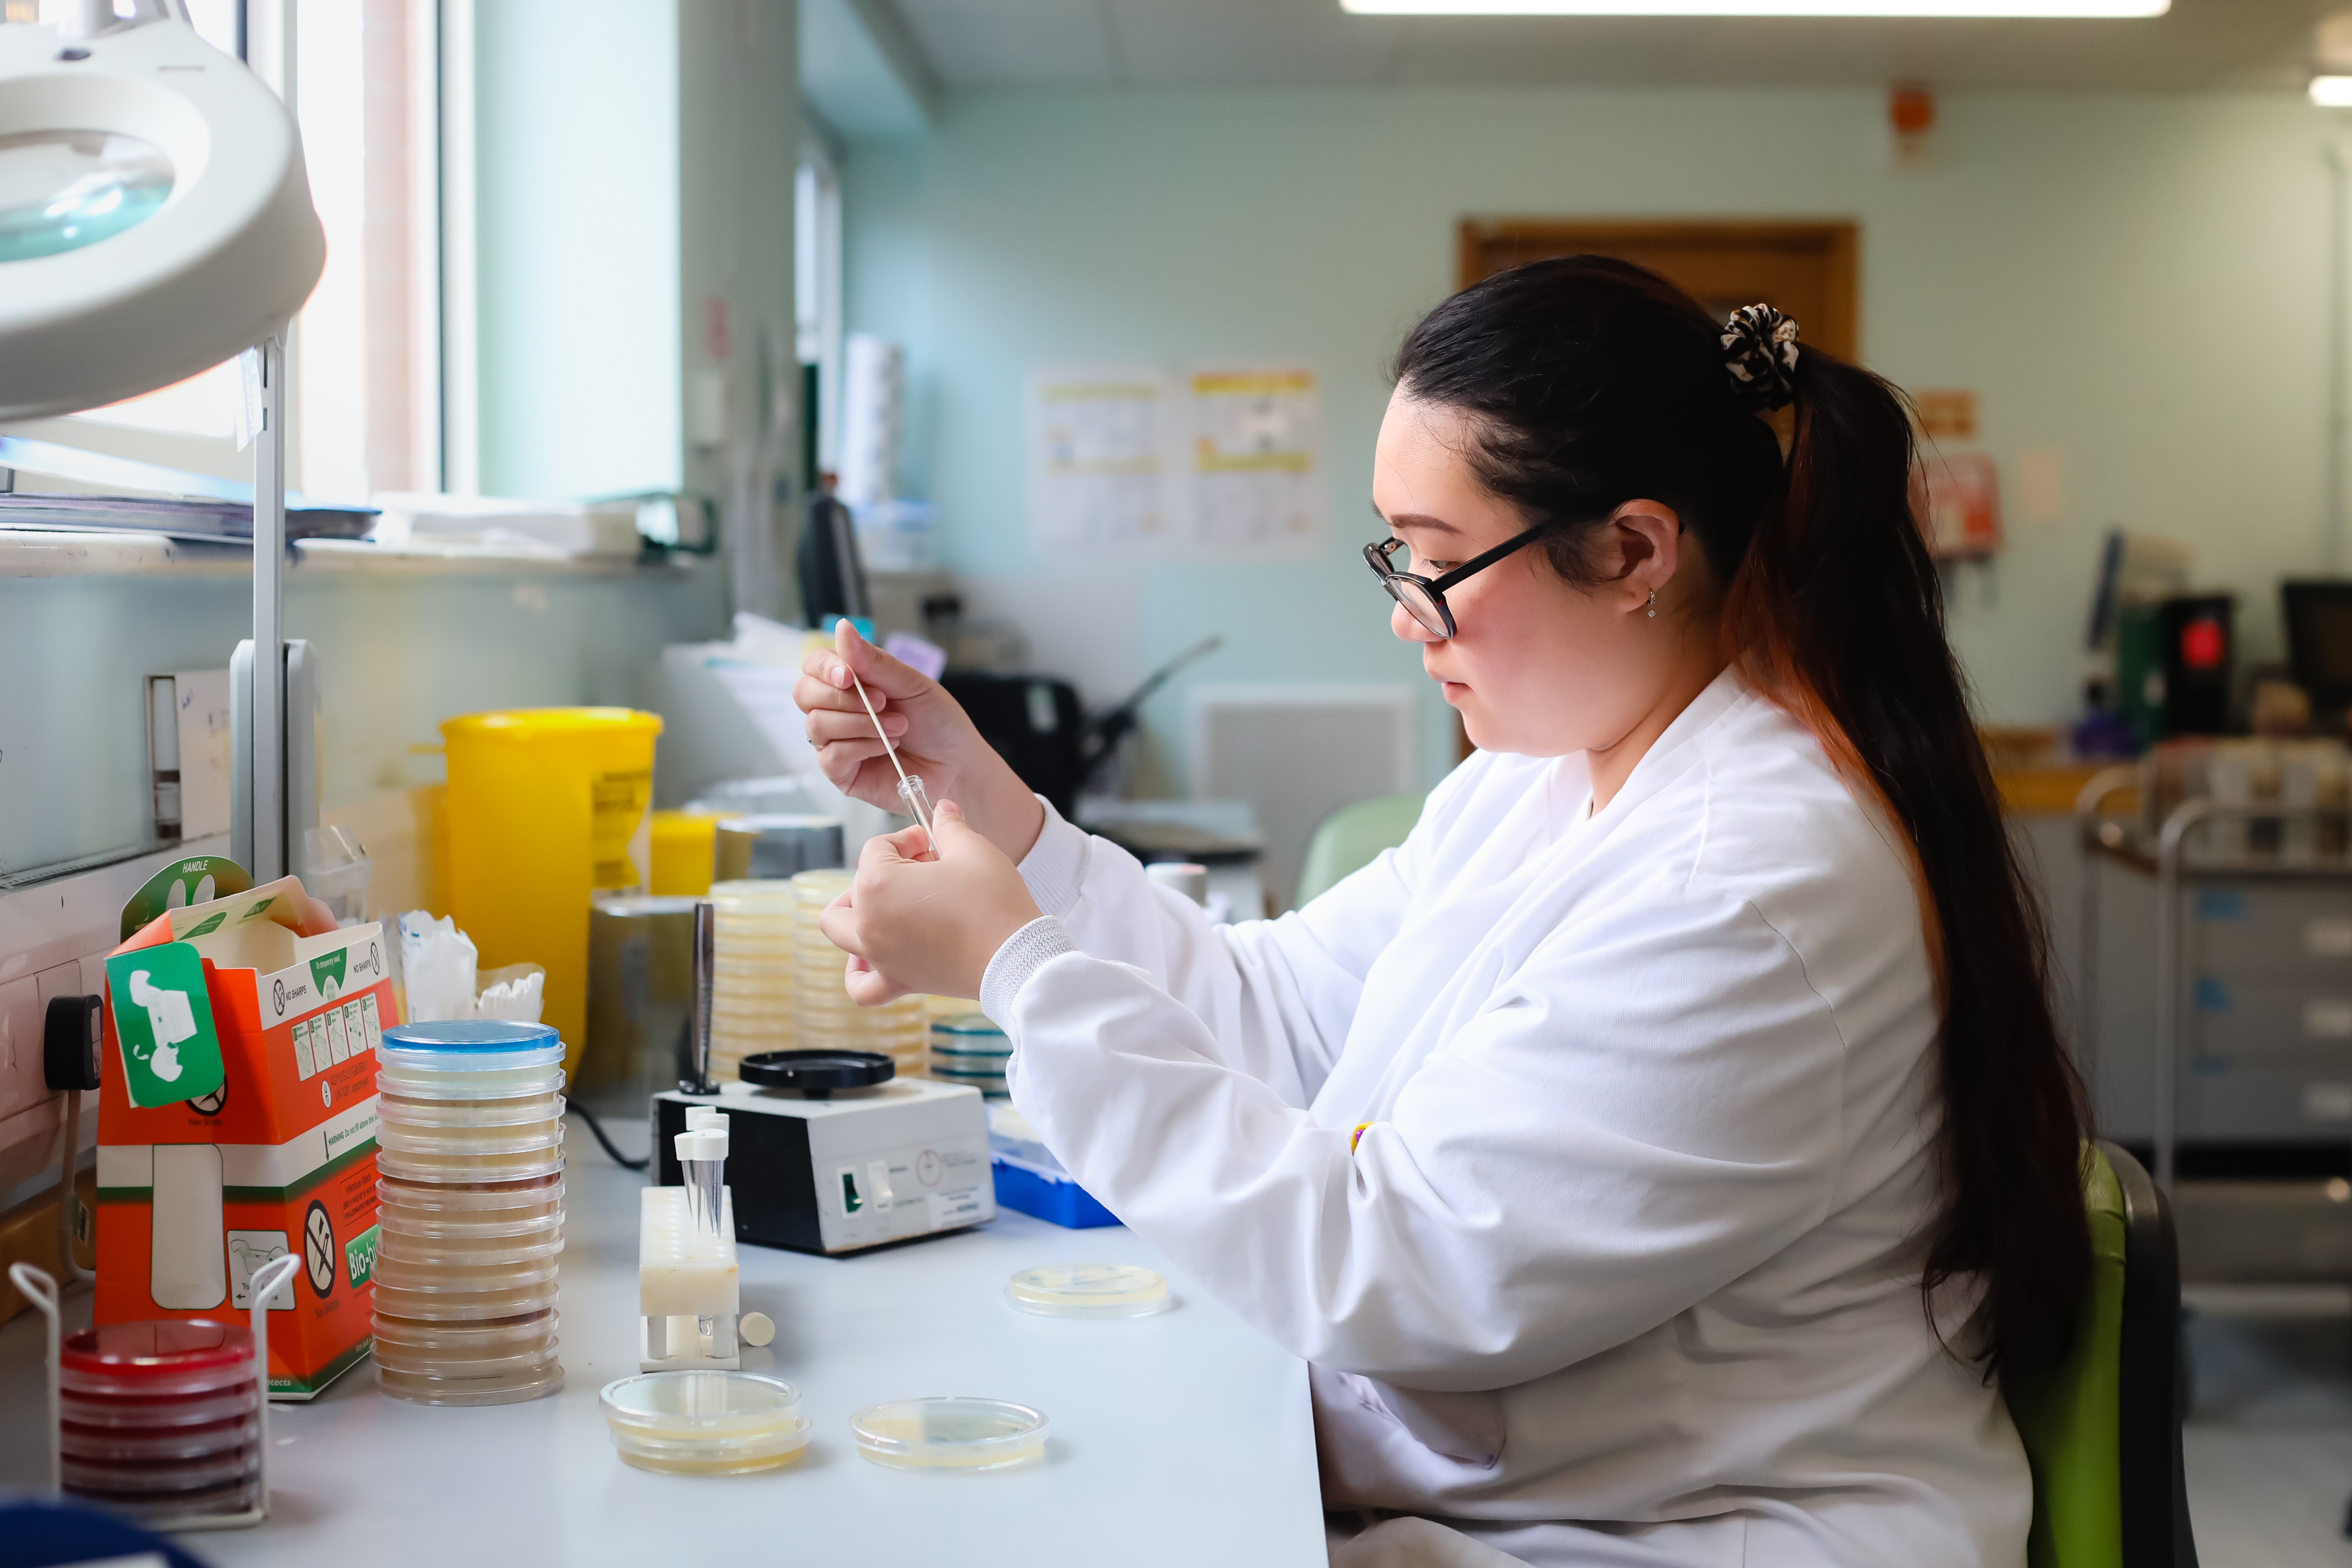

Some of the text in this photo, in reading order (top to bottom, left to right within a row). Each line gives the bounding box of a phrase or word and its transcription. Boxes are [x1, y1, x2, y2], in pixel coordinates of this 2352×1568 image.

[182, 860, 209, 873] HANDLE
[315, 961, 320, 970] To
[320, 957, 334, 968] temporary
[353, 959, 371, 973] NO SHARPS
[286, 985, 306, 1001] NO SHARPS
[328, 1131, 345, 1146] WARNING
[345, 1129, 350, 1138] Do
[360, 1120, 368, 1129] above
[348, 1237, 377, 1280] Bio-bi
